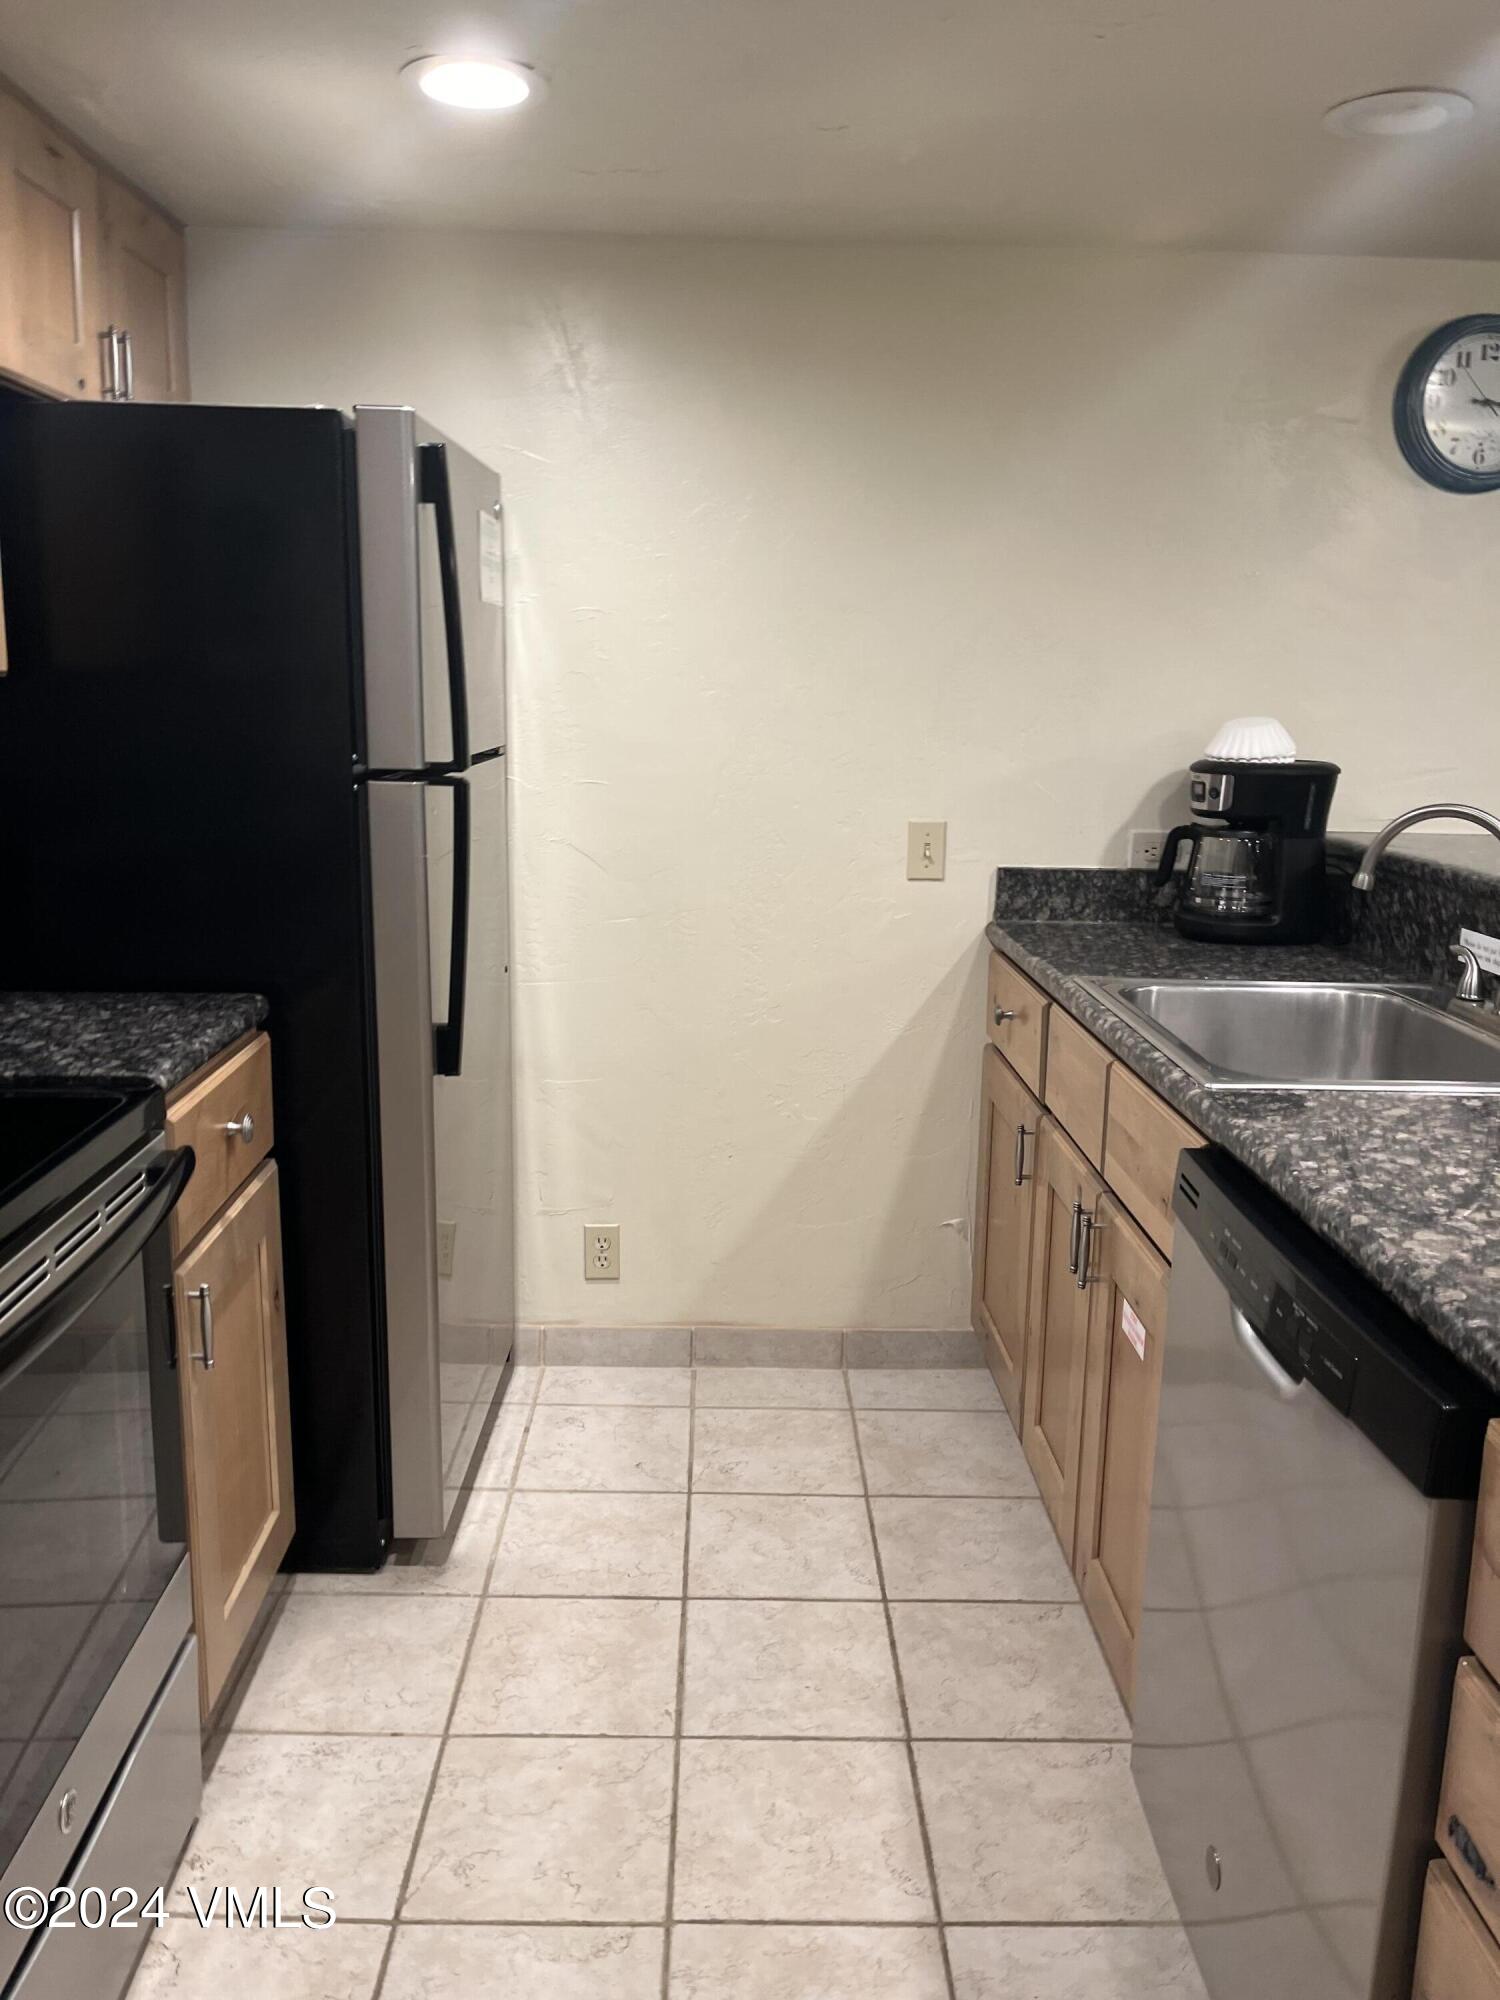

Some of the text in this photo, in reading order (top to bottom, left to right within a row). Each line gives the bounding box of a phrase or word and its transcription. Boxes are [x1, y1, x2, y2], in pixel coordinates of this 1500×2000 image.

[1456, 351, 1471, 368] 11
[1481, 343, 1500, 361] 12
[1472, 441, 1486, 465] 6
